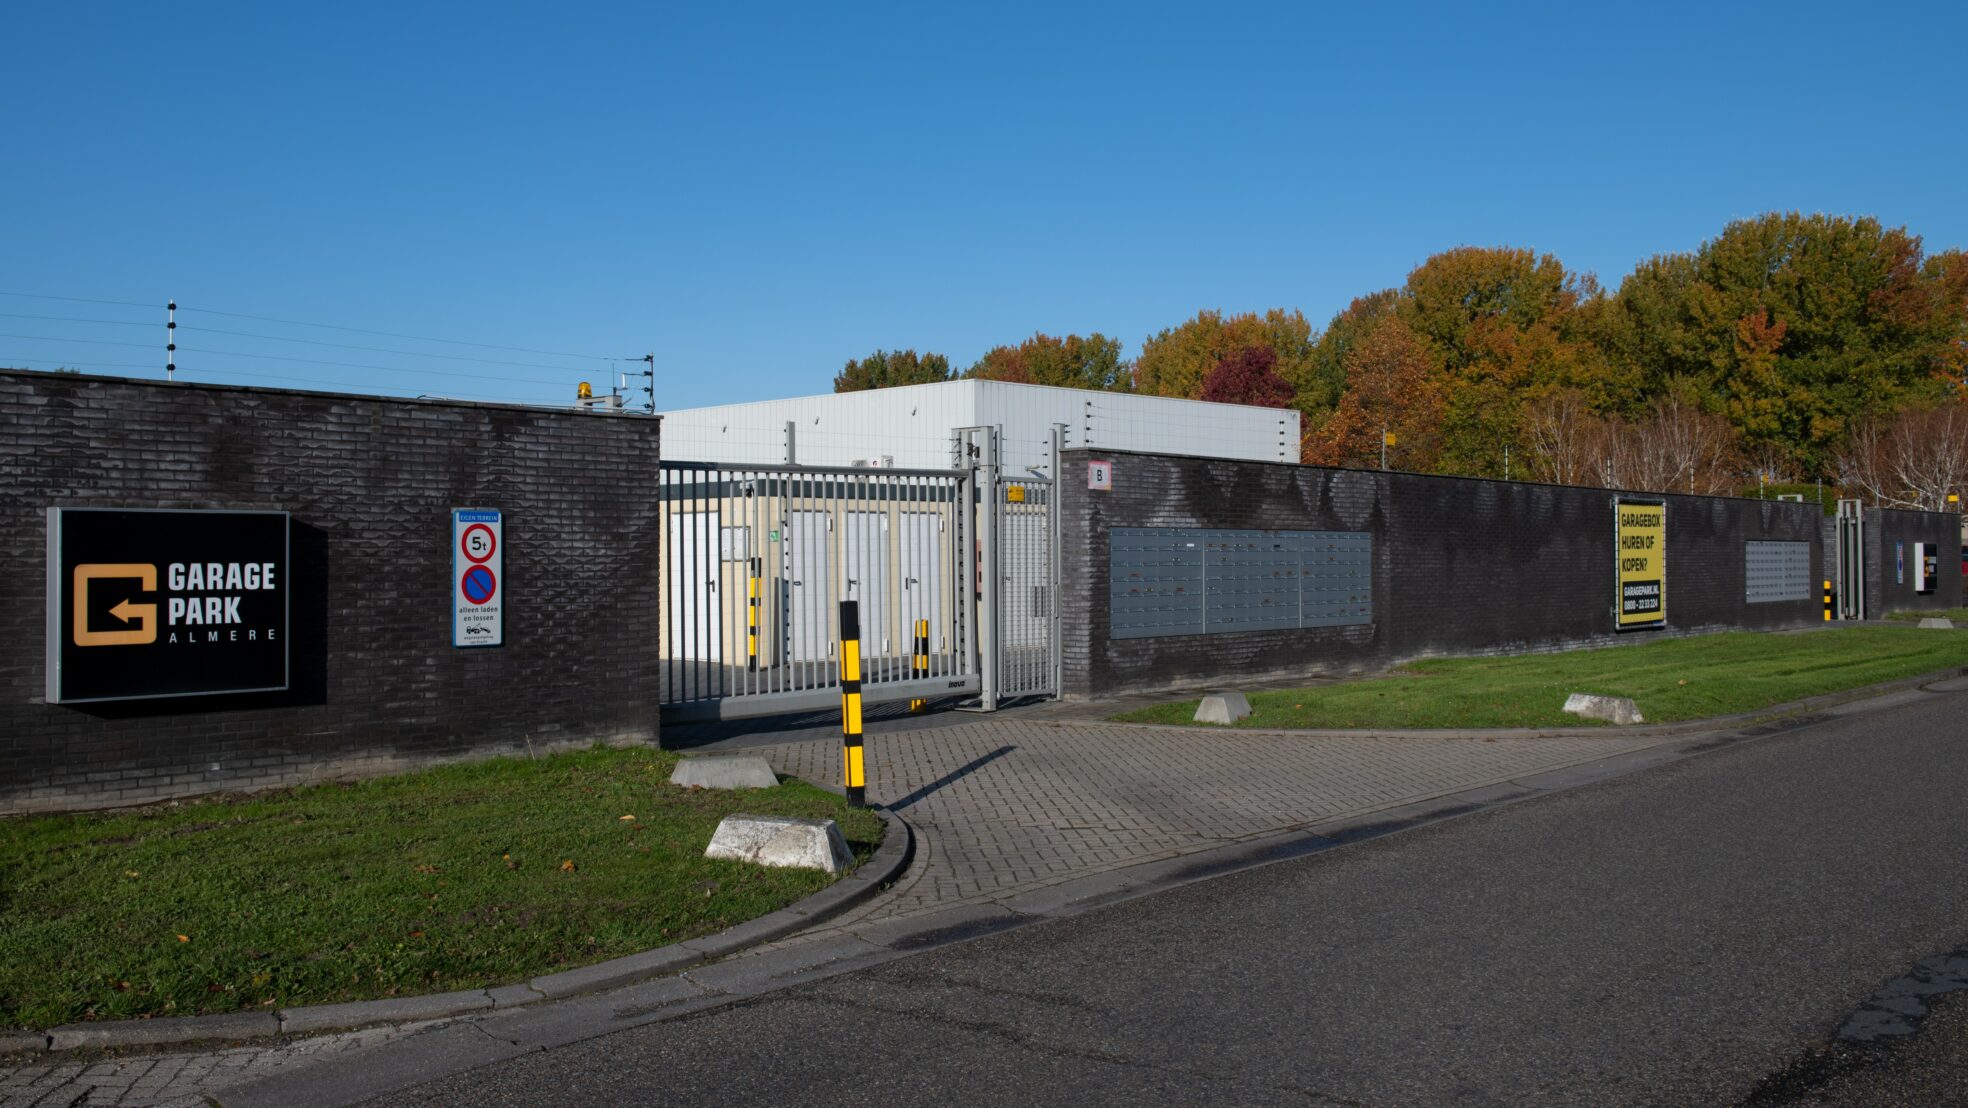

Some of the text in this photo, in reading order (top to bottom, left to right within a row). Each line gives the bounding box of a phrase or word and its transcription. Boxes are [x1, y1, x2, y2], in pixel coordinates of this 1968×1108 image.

[1097, 469, 1103, 481] B
[1621, 513, 1660, 527] GARAGEBOX
[1621, 536, 1654, 549] HUREN OF
[1622, 557, 1647, 572] KOPEN?
[168, 562, 275, 591] GARAGE
[1624, 584, 1660, 597] GARAGEPARK.NL
[168, 596, 242, 626] PARK
[480, 605, 498, 613] laden
[1624, 599, 1636, 610] 0800
[1638, 599, 1644, 609] 22
[473, 614, 494, 622] lossen
[169, 629, 275, 644] ALMERE
